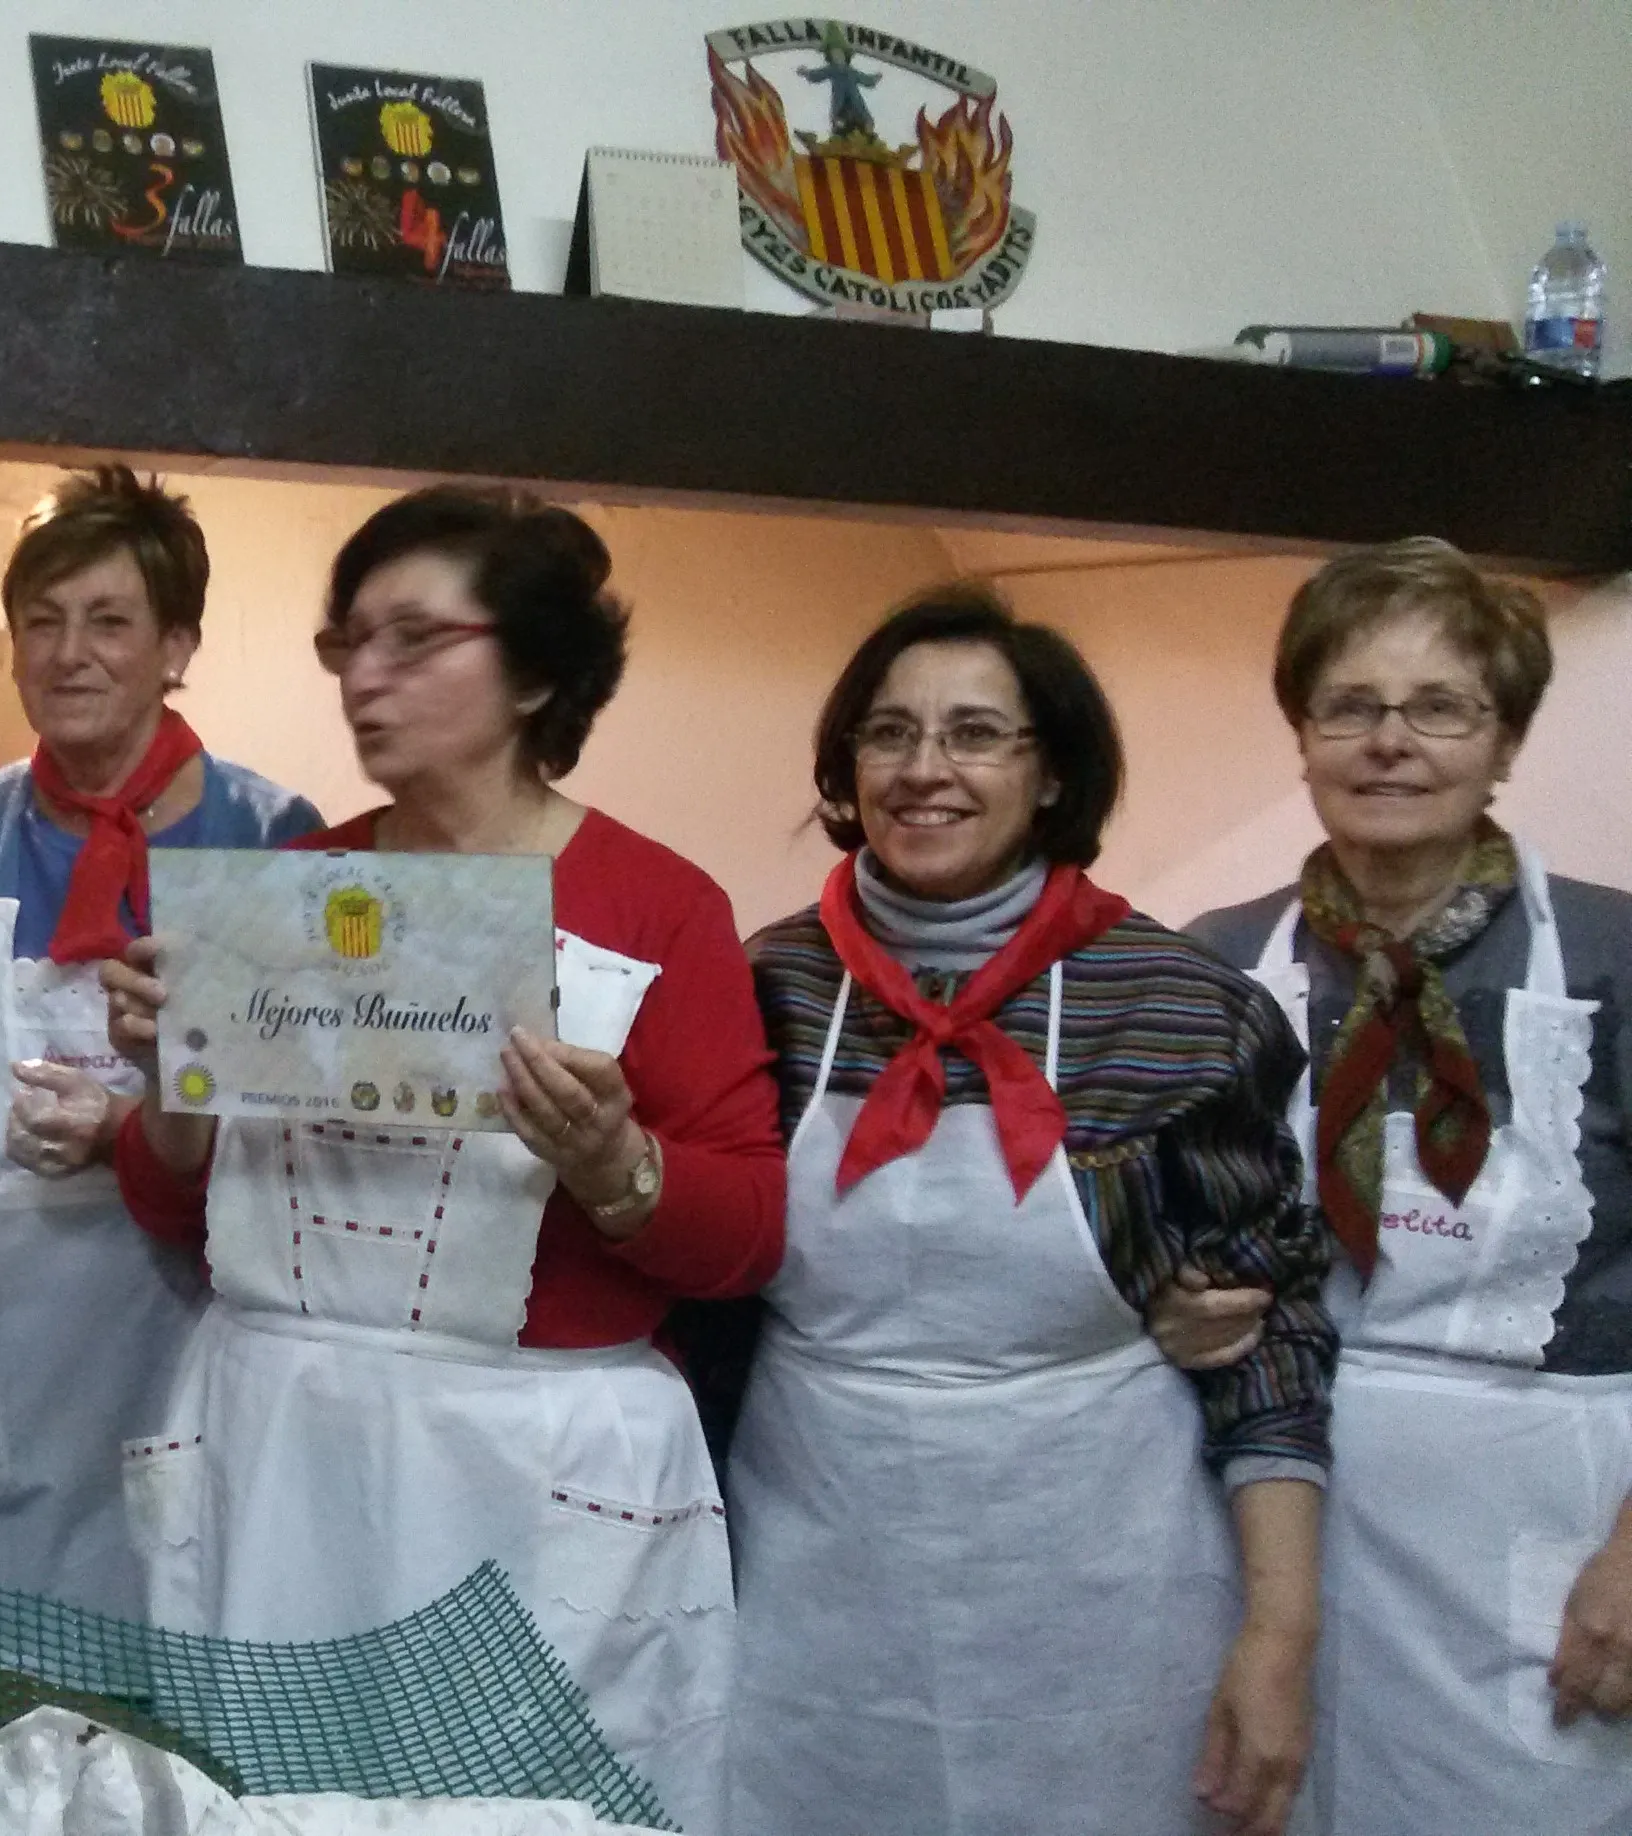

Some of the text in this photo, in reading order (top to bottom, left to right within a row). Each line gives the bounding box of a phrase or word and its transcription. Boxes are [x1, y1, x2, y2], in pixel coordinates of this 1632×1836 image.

[727, 17, 970, 86] FALLA INFANTIL
[108, 162, 235, 257] 3 fallas
[400, 188, 446, 272] 4
[738, 189, 808, 276] EYES
[231, 988, 494, 1041] Mejores Buñuelos
[1379, 1207, 1474, 1241] elita
